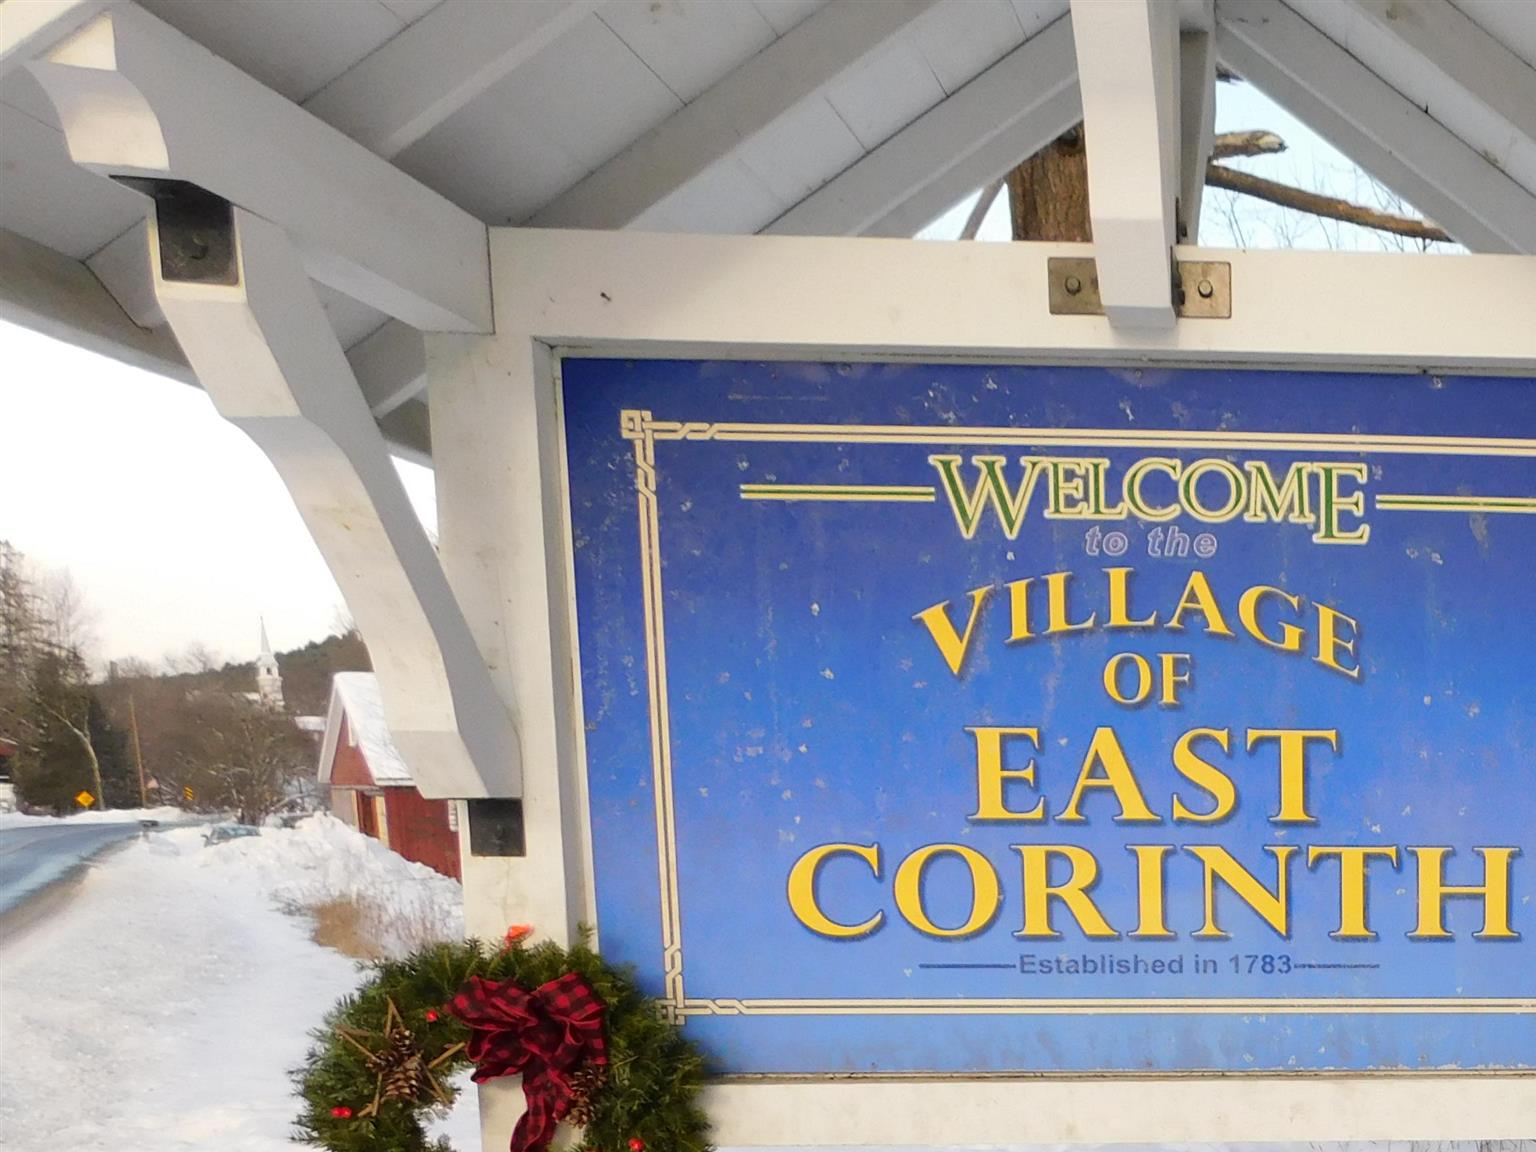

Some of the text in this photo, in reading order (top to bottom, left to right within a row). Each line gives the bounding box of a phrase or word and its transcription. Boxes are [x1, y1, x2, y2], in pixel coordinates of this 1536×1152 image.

[929, 455, 1370, 546] WELCOME
[1085, 525, 1218, 558] to the
[912, 566, 1363, 680] VILLAGE
[1103, 652, 1192, 706] OF
[964, 726, 1339, 823] EAST
[786, 842, 1522, 940] CORINTH
[1019, 953, 1293, 975] Established in 1783
